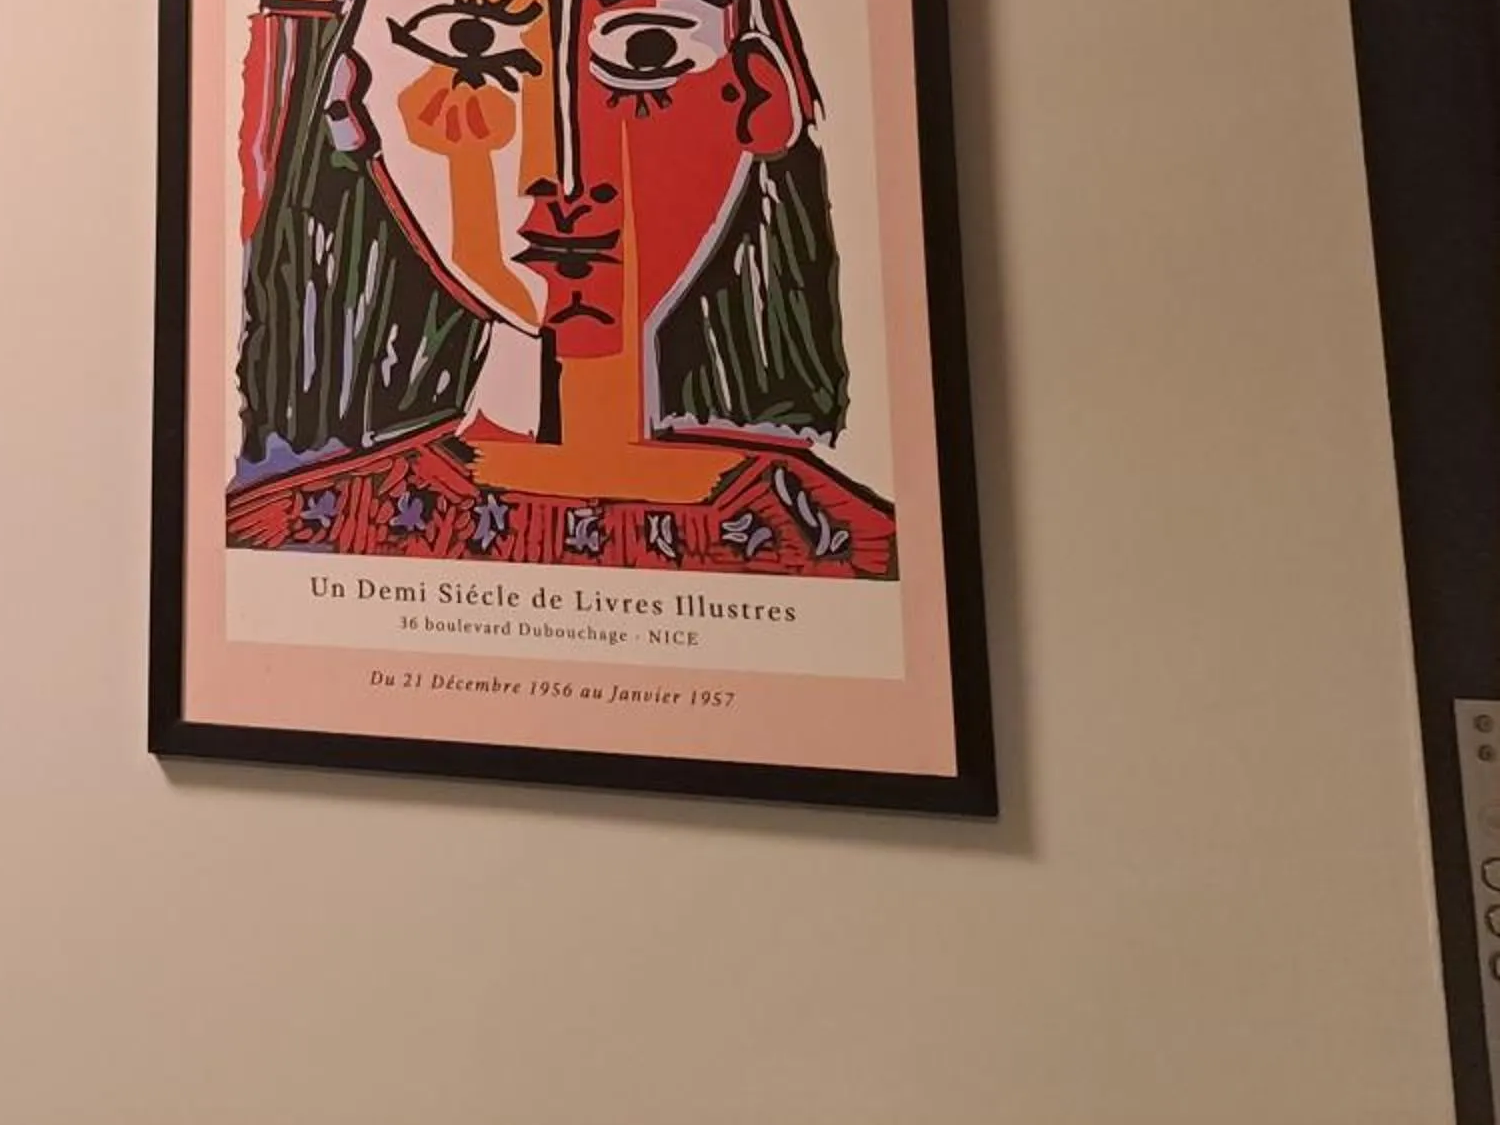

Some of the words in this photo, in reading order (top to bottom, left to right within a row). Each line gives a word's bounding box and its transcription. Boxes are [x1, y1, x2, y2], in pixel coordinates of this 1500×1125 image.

[310, 576, 346, 598] Un
[357, 578, 426, 603] Demi
[438, 582, 520, 608] Siécle
[531, 586, 563, 610] de
[575, 589, 664, 616] Livres
[675, 594, 796, 622] Illustres
[399, 615, 419, 631] 36
[424, 614, 511, 636] boulevard
[518, 621, 629, 646] Dubouchage
[648, 628, 699, 647] NICE
[370, 670, 395, 687] Du
[403, 672, 422, 688] 21
[430, 673, 521, 695] Décembre
[529, 680, 573, 698] 1956
[579, 686, 603, 700] au
[608, 684, 681, 704] Janvier
[690, 690, 736, 707] 1957
